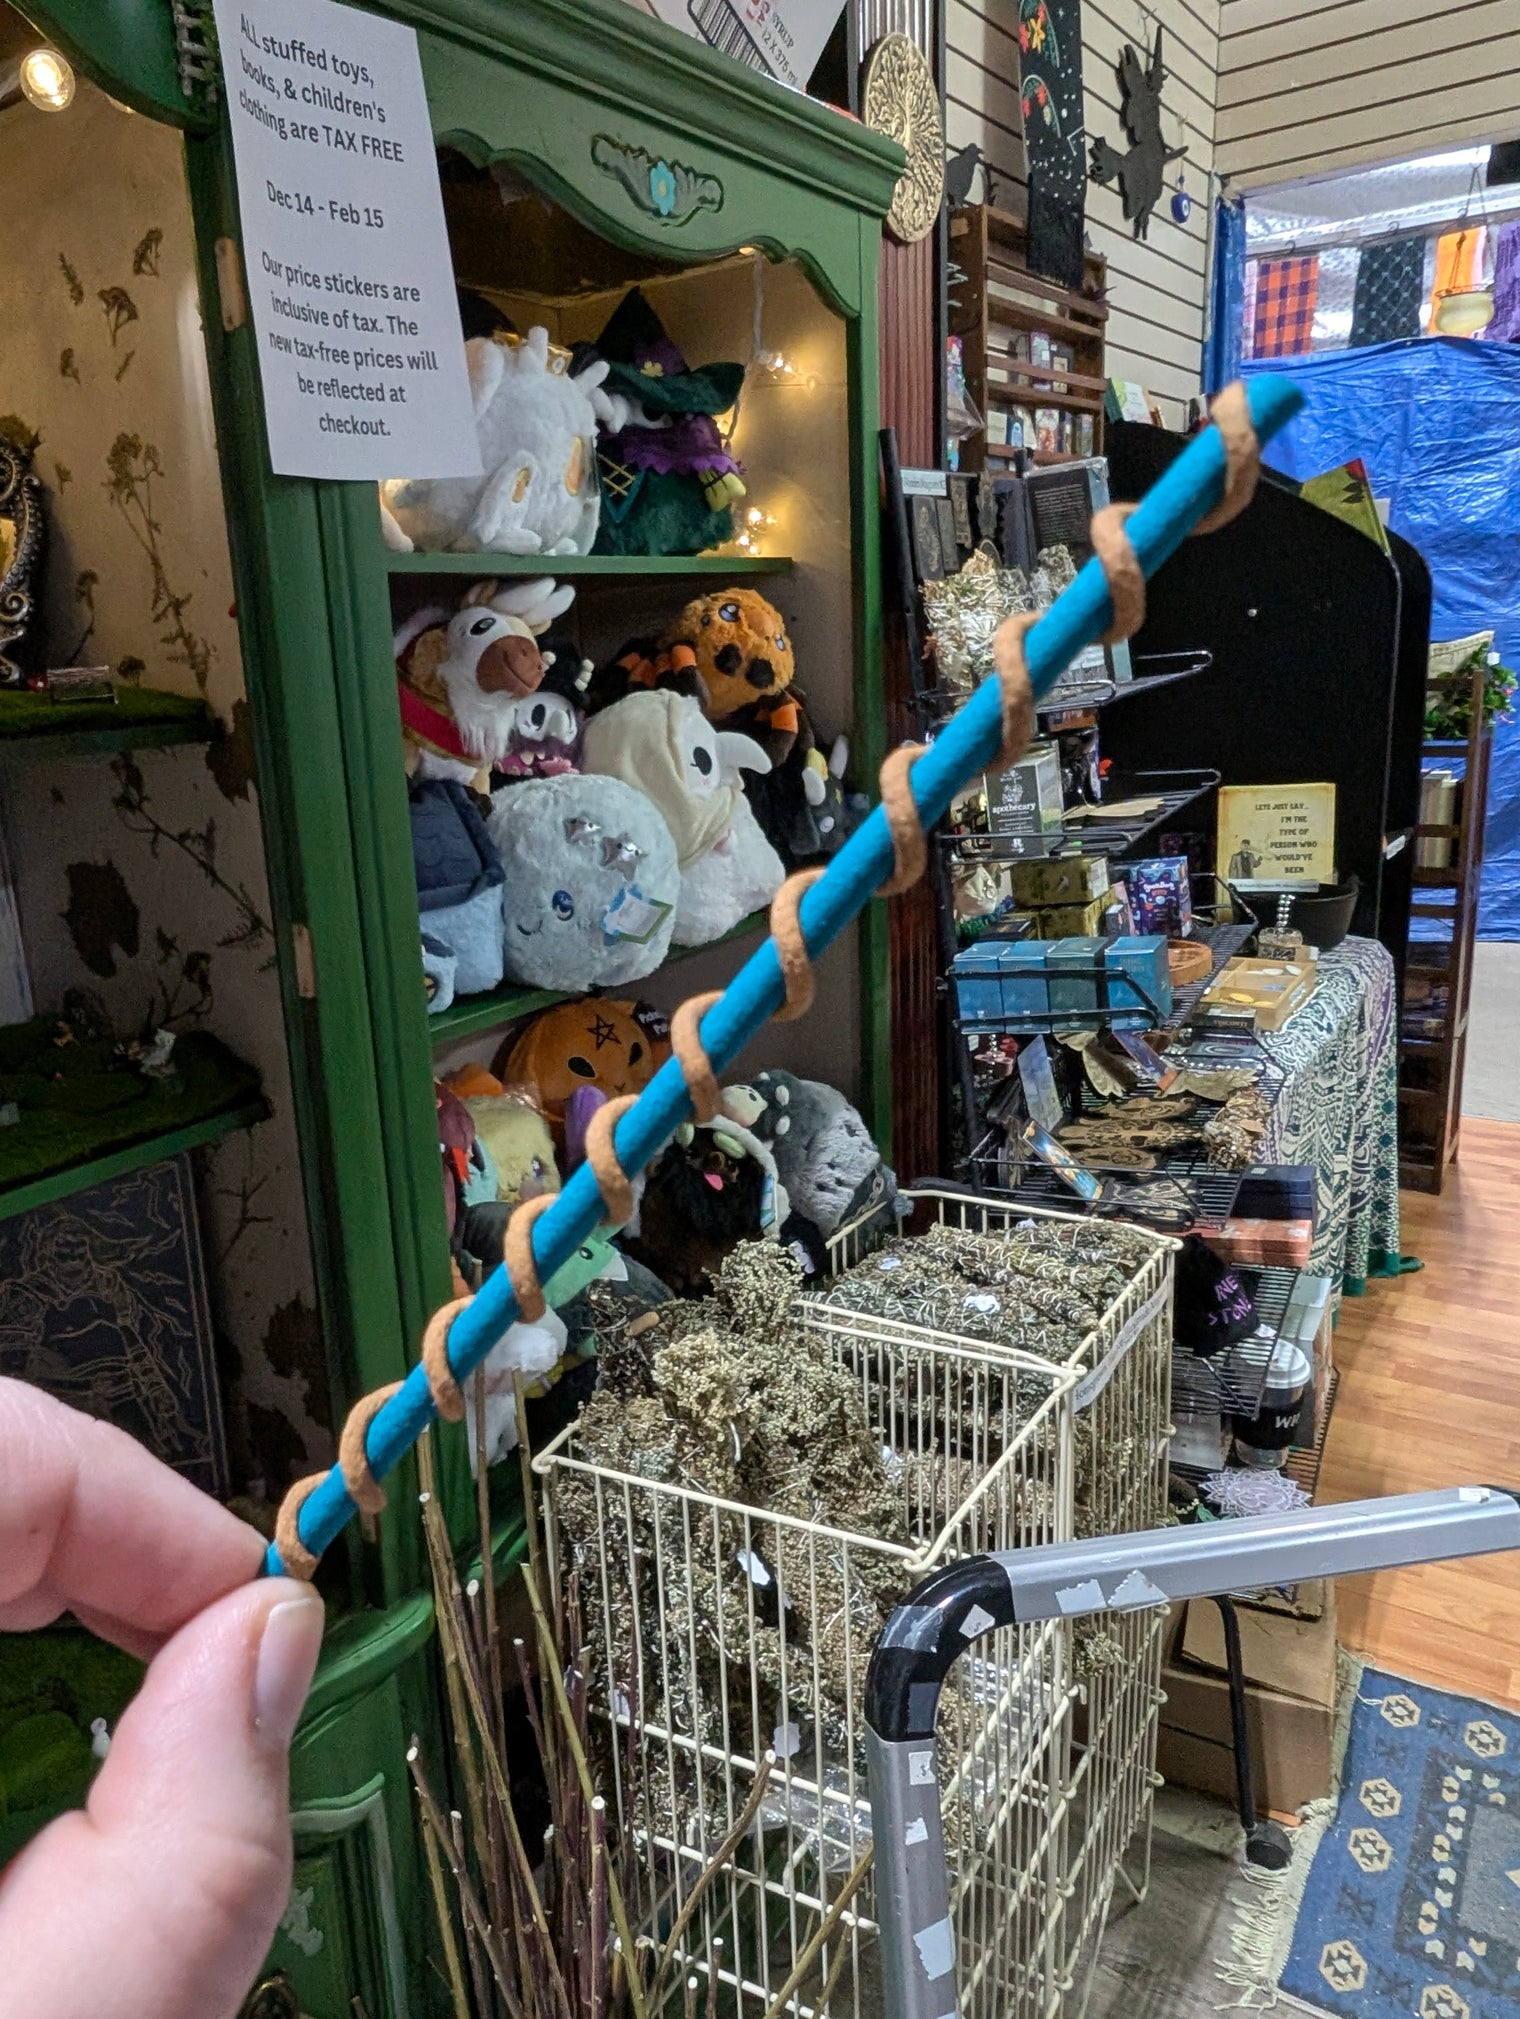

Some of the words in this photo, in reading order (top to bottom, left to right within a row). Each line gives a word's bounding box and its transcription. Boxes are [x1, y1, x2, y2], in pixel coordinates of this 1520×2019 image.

[262, 36, 328, 71] stuffed
[332, 54, 375, 88] toys,
[775, 49, 790, 72] 375
[240, 48, 281, 100] books,
[283, 78, 297, 100] &
[301, 83, 386, 123] children's
[240, 88, 288, 140] clothing
[290, 121, 319, 143] are
[322, 125, 357, 152] TAX
[361, 135, 404, 163] FREE
[266, 180, 293, 210] Dec
[294, 193, 314, 215] 14
[329, 200, 360, 225] Feb
[365, 208, 384, 228] 15
[262, 251, 283, 277] Our
[285, 265, 321, 290] price
[324, 273, 389, 300] stickers
[393, 285, 420, 302] are
[271, 291, 330, 327] inclusive
[333, 309, 350, 330] of
[352, 313, 384, 333] tax.
[386, 315, 419, 336] The
[268, 331, 292, 352] new
[294, 338, 350, 365] tax-free
[354, 348, 404, 371] prices
[407, 351, 439, 370] will
[297, 372, 315, 394] be
[317, 378, 385, 402] reflected
[389, 385, 407, 403] at
[319, 412, 391, 436] checkout.
[992, 802, 1036, 815] apothecary
[1270, 841, 1297, 849] PERSON
